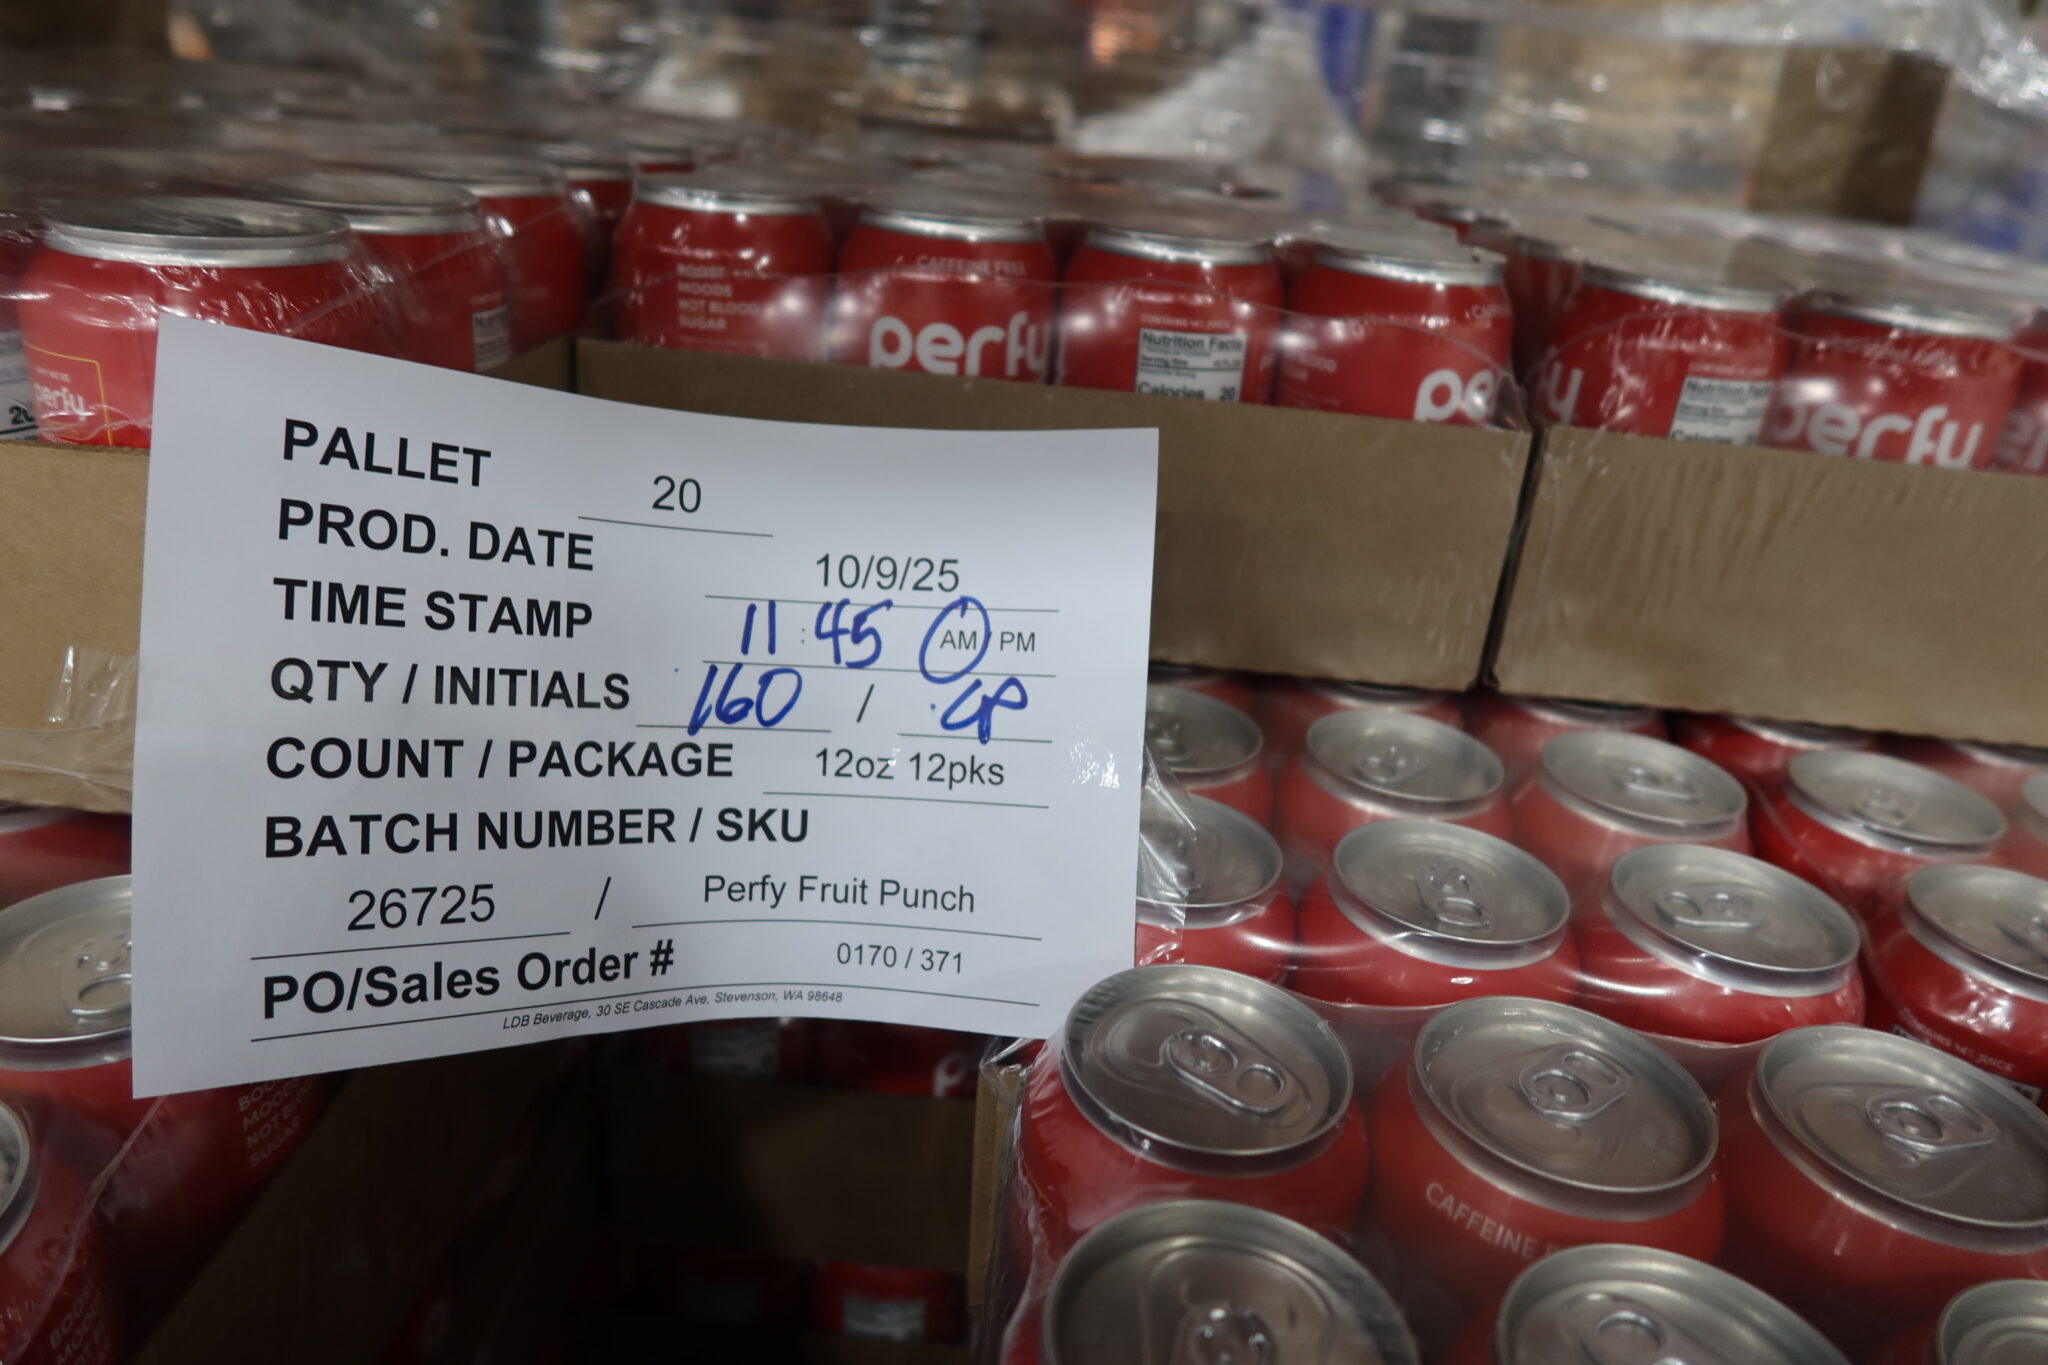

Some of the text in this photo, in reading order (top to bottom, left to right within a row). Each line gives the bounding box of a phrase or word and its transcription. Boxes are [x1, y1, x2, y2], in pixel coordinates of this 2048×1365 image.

[1142, 331, 1243, 351] Nutrition Facts
[283, 418, 493, 488] PALLET
[652, 476, 701, 513] 20
[278, 498, 594, 571] PROD. DATE
[816, 553, 960, 593] 10/9/25
[273, 577, 593, 639] TIME STAMP
[940, 630, 977, 650] AM
[1000, 631, 1036, 652] PM
[270, 657, 630, 710] QTY / INITIALS
[687, 662, 802, 736] 160
[266, 737, 734, 779] COUNT / PACKAGE
[815, 748, 1005, 791] 12oz 12pks
[265, 807, 809, 858] BATCH NUMBER / SKU
[347, 883, 496, 932] 26725
[704, 874, 975, 913] Perfy Fruit Punch
[263, 939, 675, 1020] PO/Sales Order #
[836, 942, 963, 974] 0170 / 371
[503, 990, 843, 1029] LDB Beverage, 30 SE Cascade Ave, Stevenson, WA 98648
[1426, 1182, 1537, 1260] CAFFEINE
